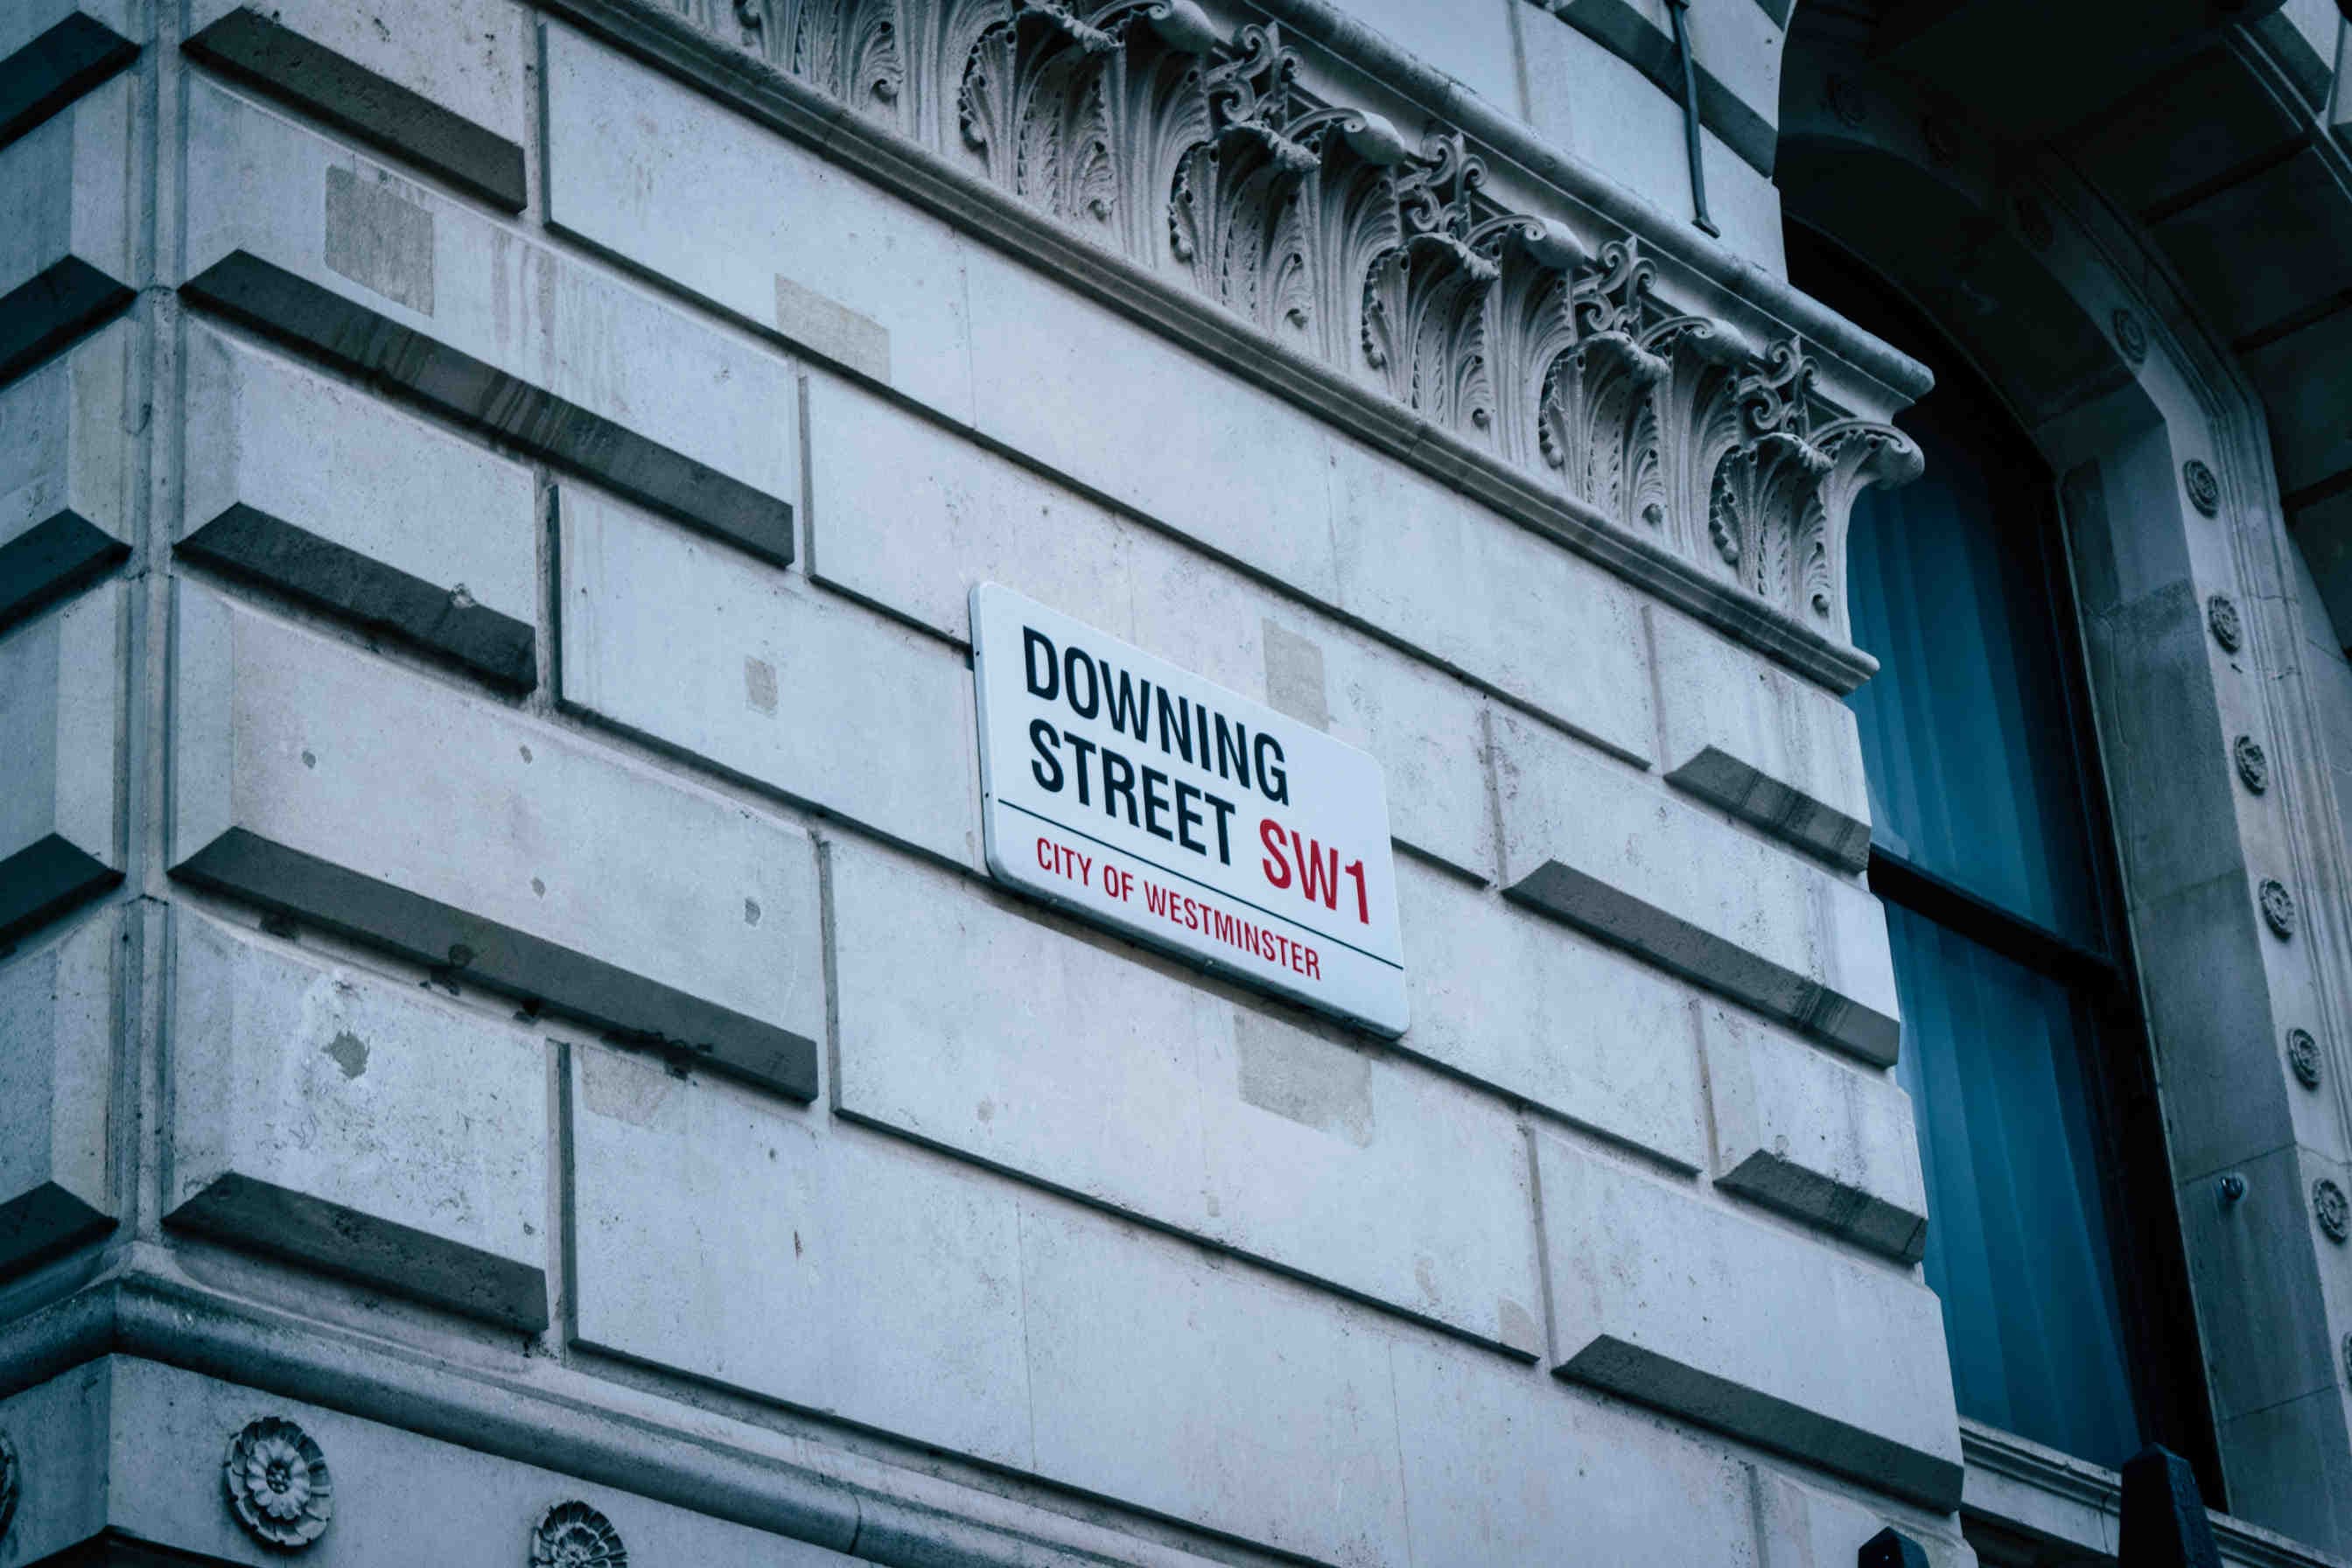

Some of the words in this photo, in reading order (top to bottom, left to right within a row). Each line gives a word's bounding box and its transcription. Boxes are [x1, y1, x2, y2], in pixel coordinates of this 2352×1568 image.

[1023, 625, 1289, 806] DOWNING
[1029, 718, 1236, 865] STREET
[1260, 818, 1370, 925] SW1
[1037, 837, 1092, 886] CITY
[1104, 864, 1135, 902] OF
[1144, 881, 1321, 980] WESTMINSTER
